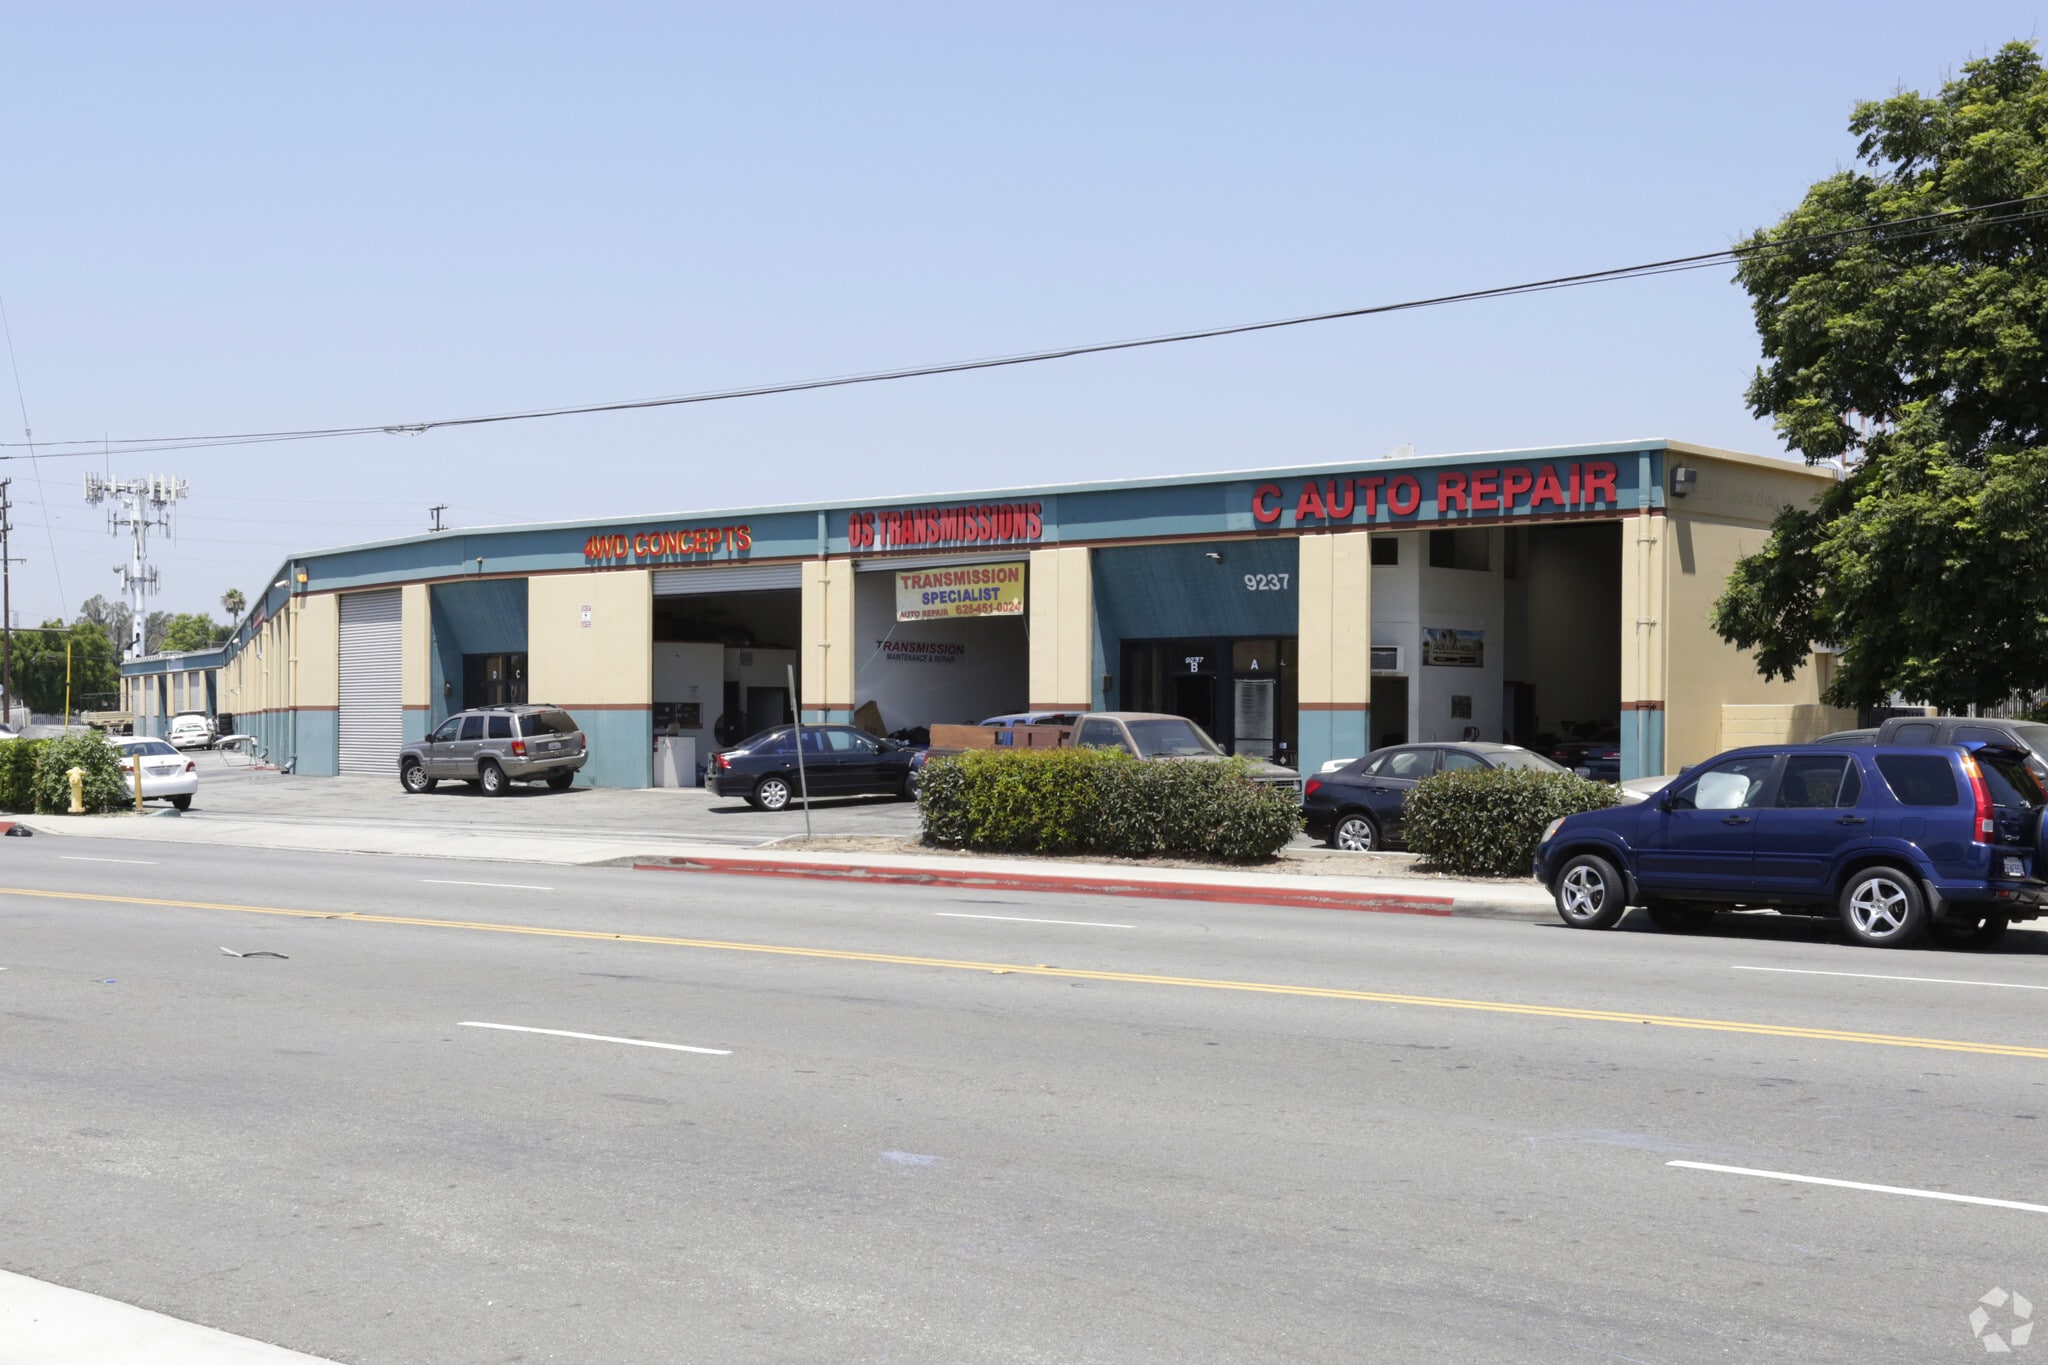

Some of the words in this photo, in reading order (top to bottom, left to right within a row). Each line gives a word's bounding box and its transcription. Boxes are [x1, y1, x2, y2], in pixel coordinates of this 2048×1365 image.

[1253, 484, 1282, 523] C
[1294, 475, 1420, 520] AUTO
[1437, 461, 1618, 512] REPAIR
[877, 502, 1042, 546] TRANSMISSIONS
[583, 534, 629, 559] 4WD
[633, 525, 752, 557] CONCEPTS
[901, 567, 1019, 589] TRANSMISSION
[1244, 573, 1289, 591] 9237
[922, 587, 1000, 605] SPECIALIST
[900, 610, 920, 619] AUTO
[922, 608, 949, 617] REPAIR
[876, 640, 965, 655] TRANSMISSION
[886, 653, 928, 662] MAINTENANCE
[1250, 659, 1259, 670] A
[515, 669, 521, 679] C
[1190, 662, 1198, 673] B
